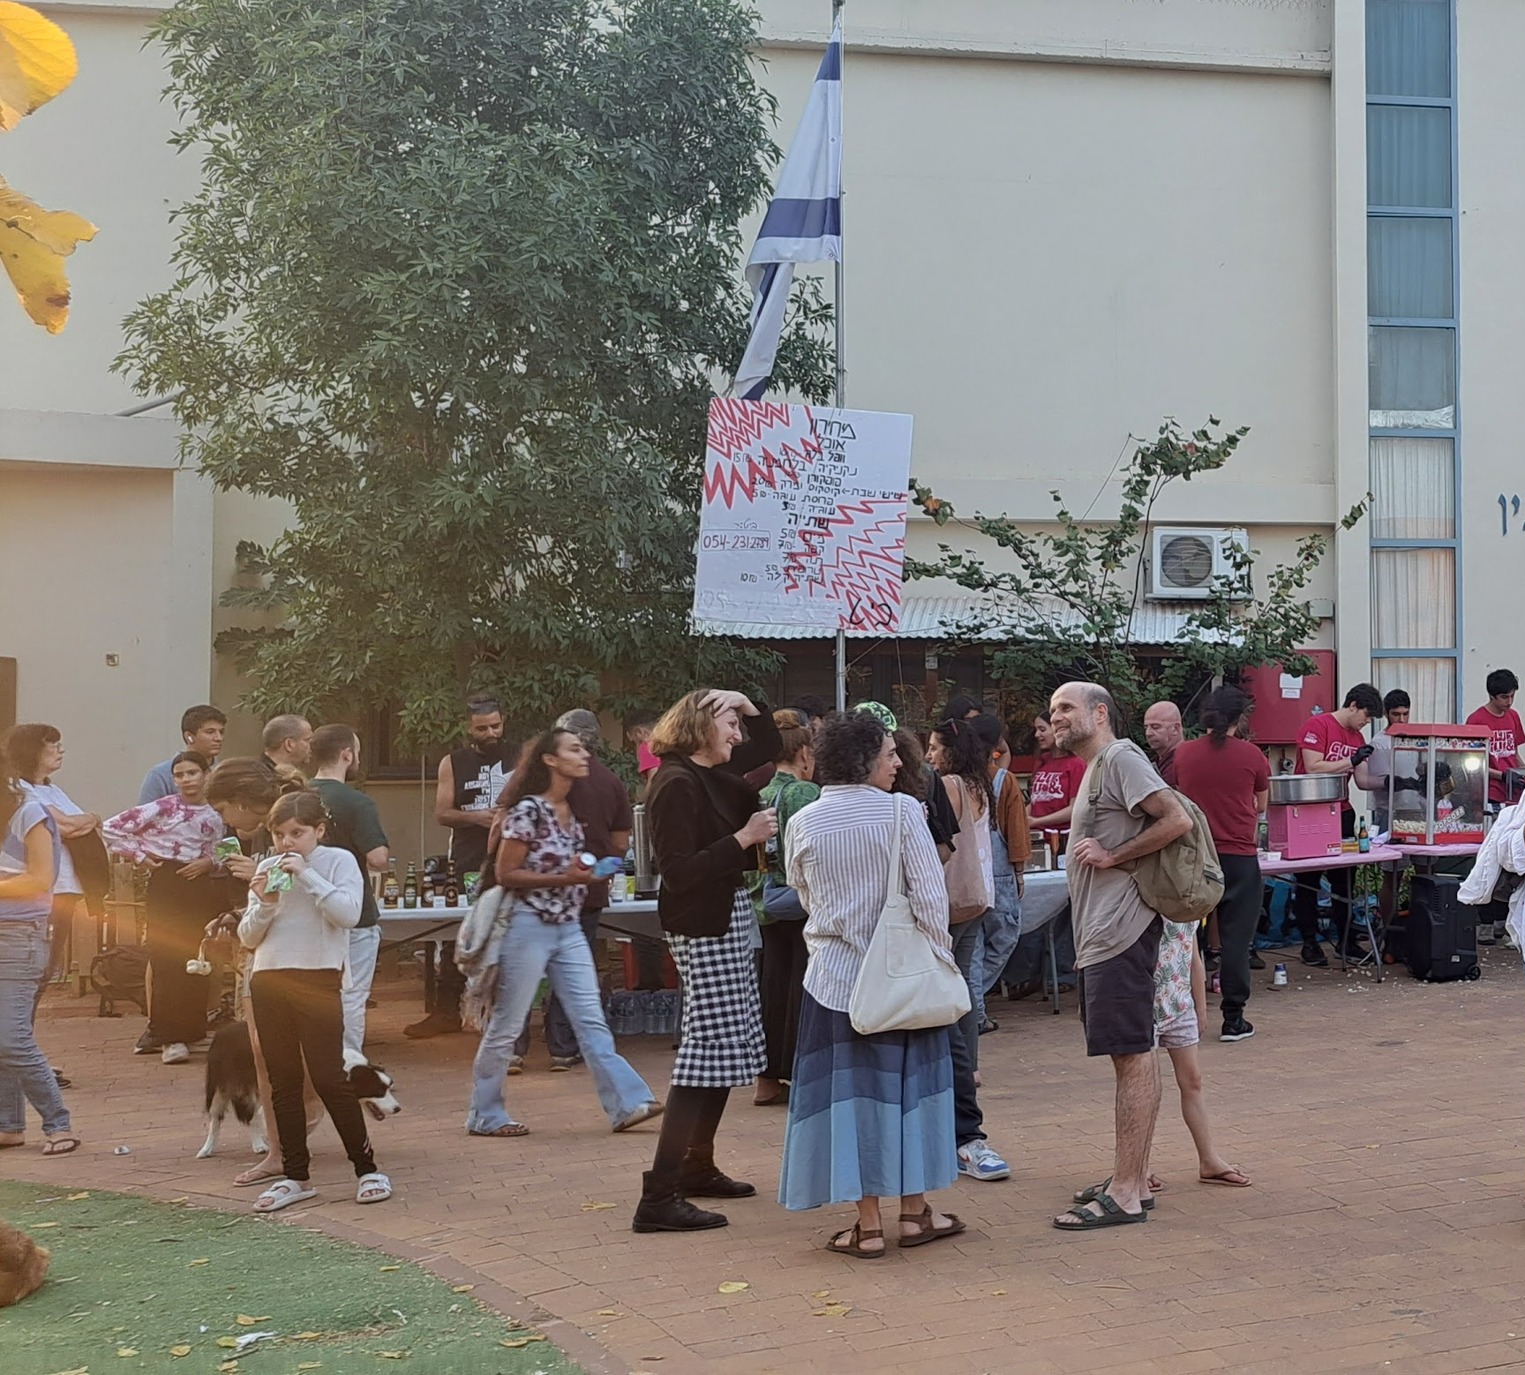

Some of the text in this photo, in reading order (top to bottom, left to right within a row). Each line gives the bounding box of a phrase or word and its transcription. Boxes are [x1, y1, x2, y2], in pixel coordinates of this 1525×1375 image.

[809, 417, 857, 440] מחירון
[817, 434, 846, 451] אוכל
[850, 487, 876, 499] שבת
